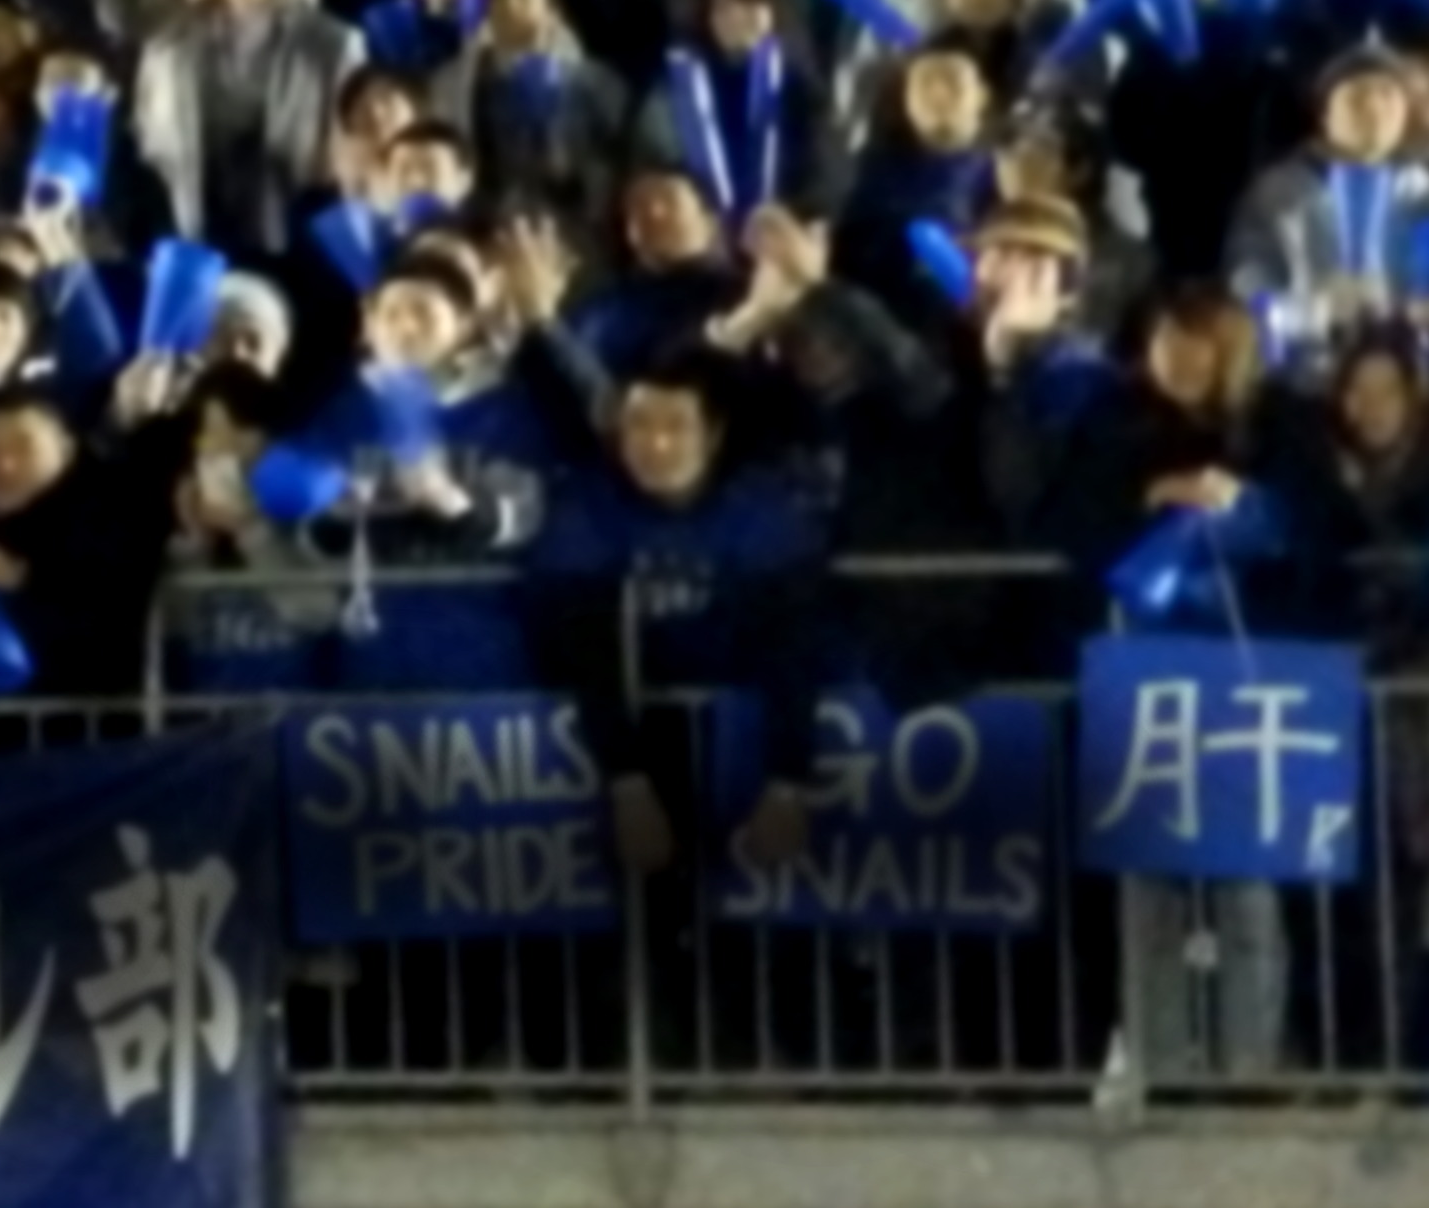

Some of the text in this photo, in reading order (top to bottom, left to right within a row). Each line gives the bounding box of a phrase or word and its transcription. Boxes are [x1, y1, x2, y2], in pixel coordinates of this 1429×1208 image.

[299, 704, 603, 826] SNAILS
[349, 816, 619, 916] PRIDE
[720, 832, 1043, 923] SNAILS
